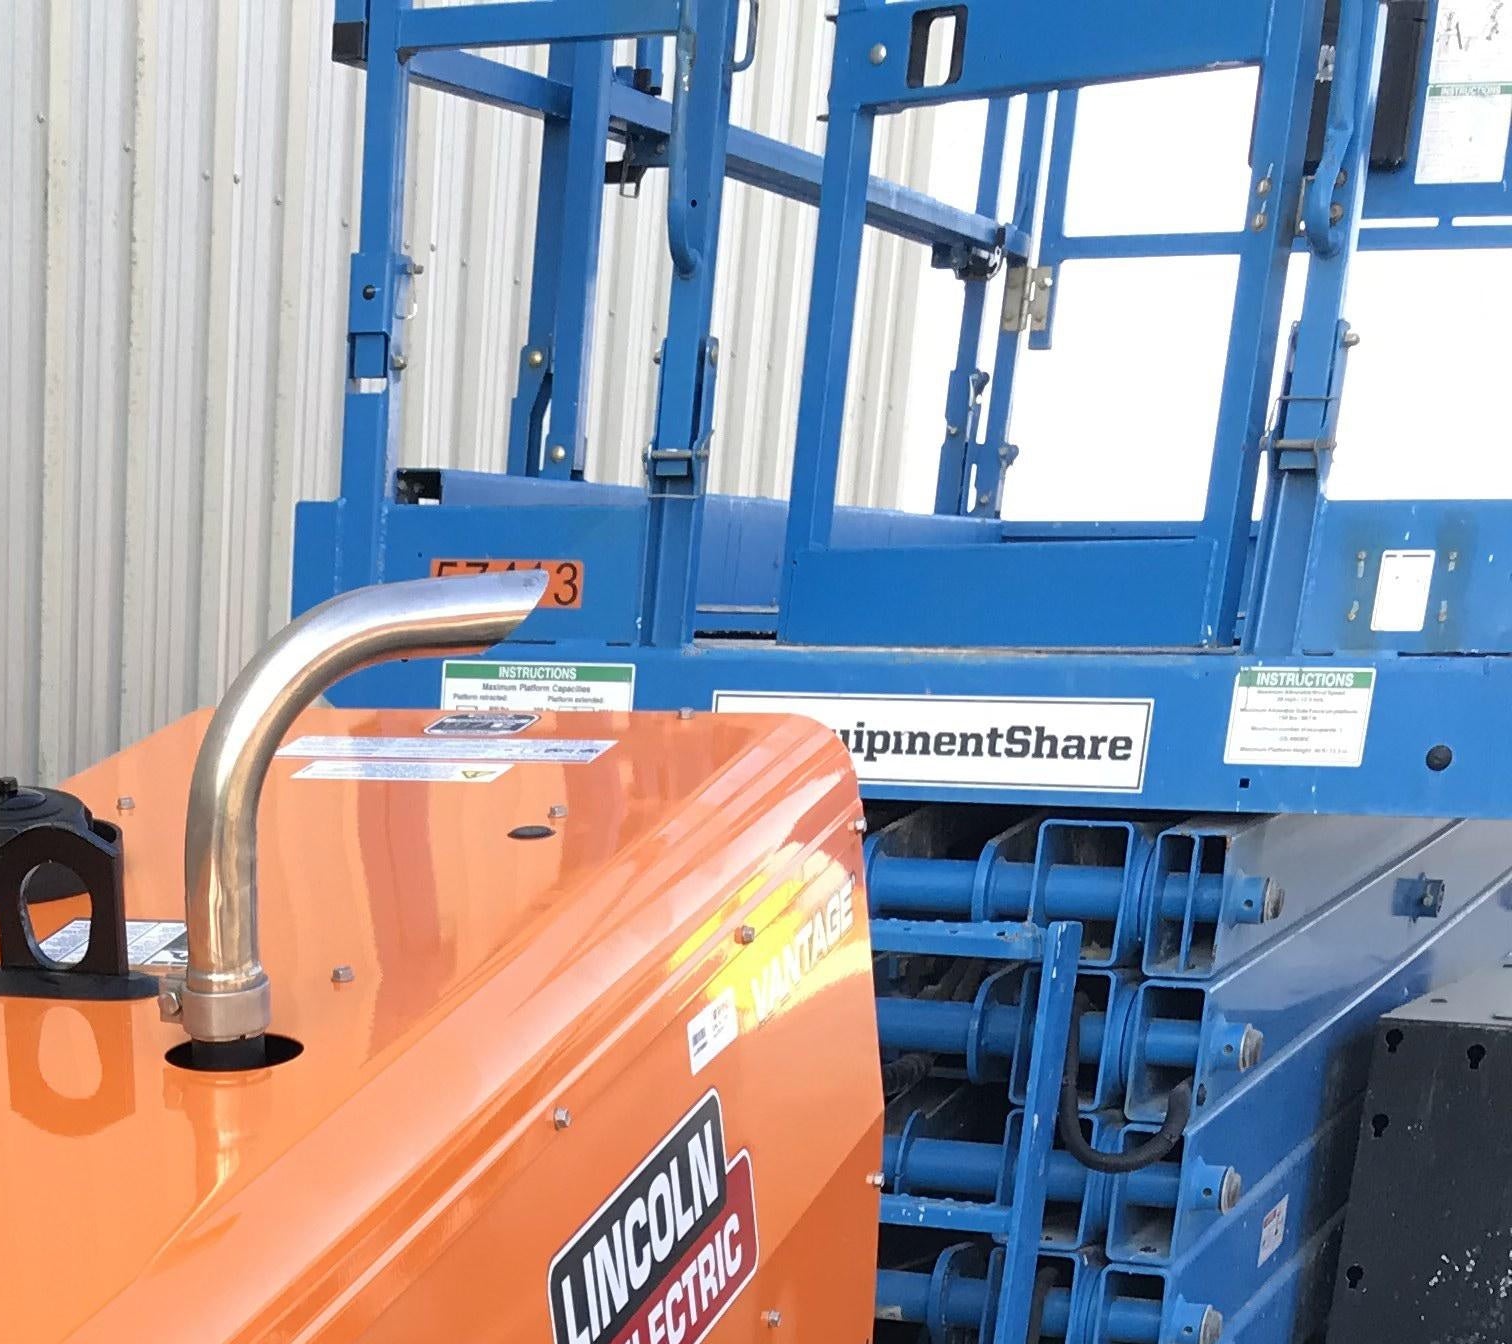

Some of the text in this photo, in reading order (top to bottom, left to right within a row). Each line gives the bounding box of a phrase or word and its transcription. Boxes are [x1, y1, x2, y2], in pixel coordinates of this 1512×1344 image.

[498, 666, 577, 680] INSTRUCTIONS
[1256, 671, 1355, 688] INSTRUCTIONS
[482, 683, 517, 692] Maximum
[519, 683, 550, 692] Platform
[831, 721, 1133, 762] uipmentShare
